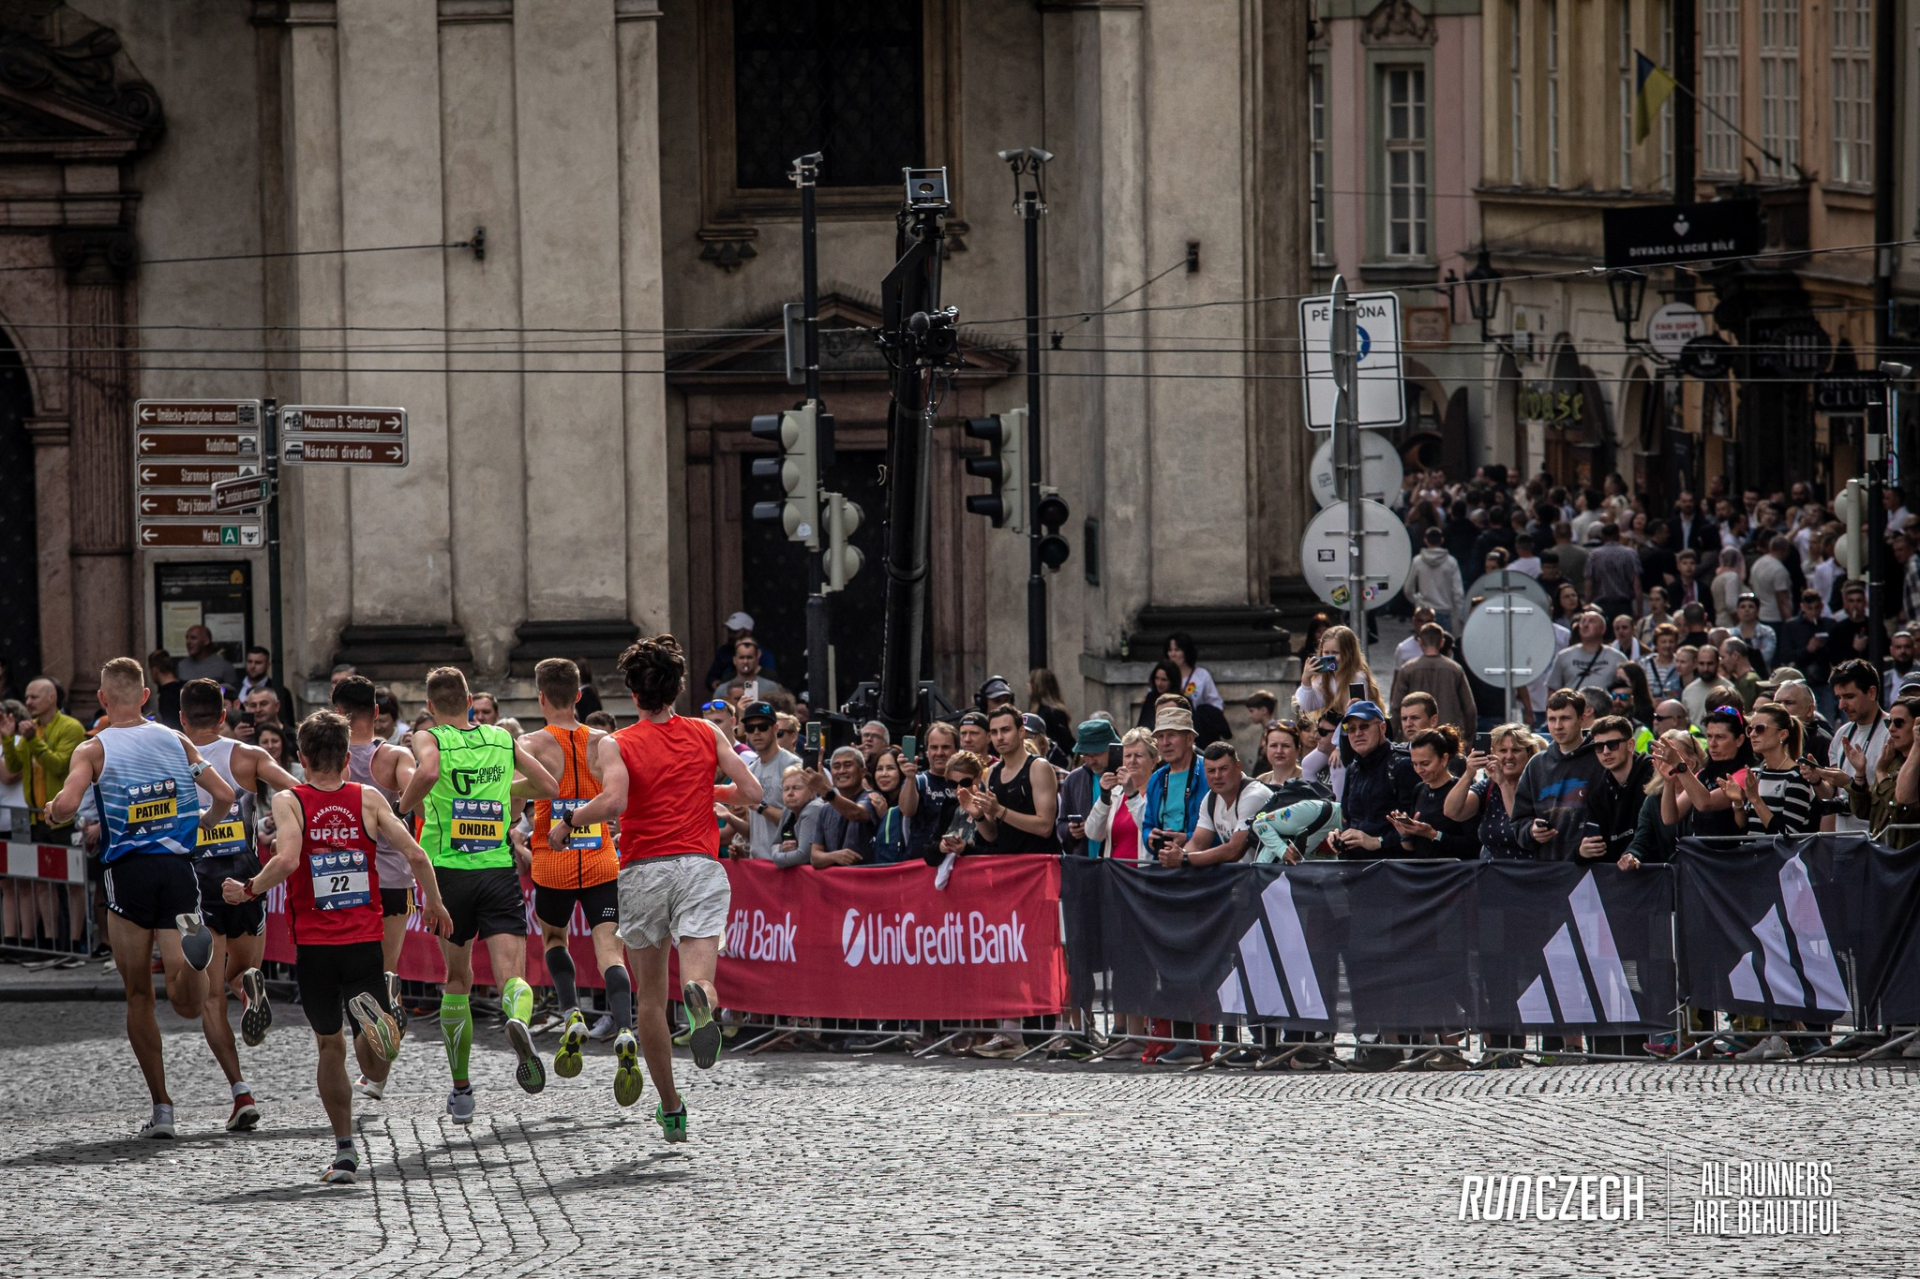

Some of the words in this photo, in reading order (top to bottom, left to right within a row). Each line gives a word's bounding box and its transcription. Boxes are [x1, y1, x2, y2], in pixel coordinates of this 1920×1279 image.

[1629, 245, 1675, 257] DIVADLO
[1677, 242, 1708, 253] LUCIE
[304, 415, 337, 428] Muzeum
[338, 415, 345, 428] B.
[347, 415, 380, 432] Smetany
[206, 438, 237, 452] Rudolfinum
[305, 444, 338, 458] Národní
[342, 445, 372, 459] divadlo
[181, 468, 209, 482] Staronová
[177, 498, 194, 515] Starý
[203, 529, 220, 542] Metro
[225, 528, 236, 543] A
[135, 802, 171, 819] PATRIK
[203, 826, 235, 842] JIRKA
[459, 822, 496, 837] ONDRA
[330, 875, 350, 893] 22
[753, 909, 797, 962] Bank
[868, 911, 965, 965] UniCredit
[969, 910, 1028, 964] Bank
